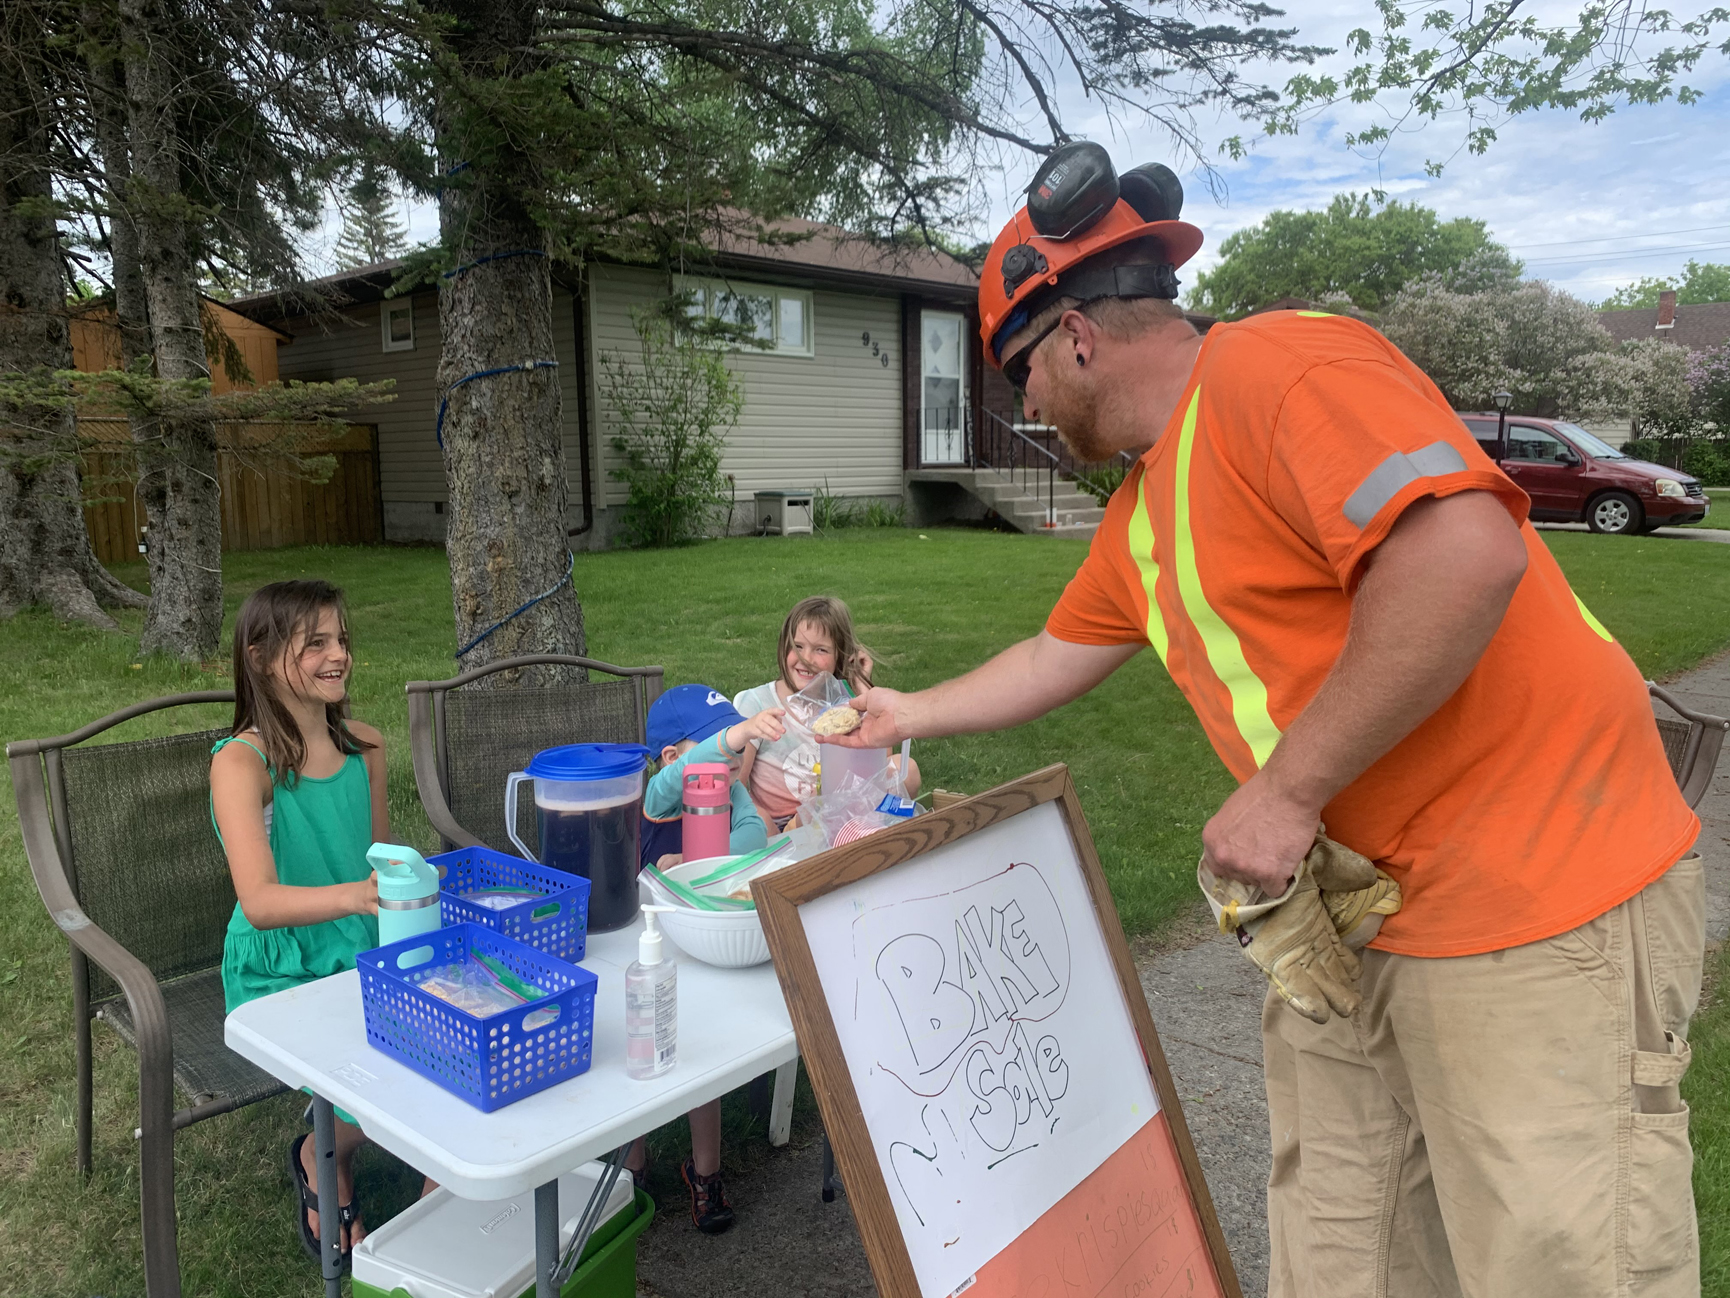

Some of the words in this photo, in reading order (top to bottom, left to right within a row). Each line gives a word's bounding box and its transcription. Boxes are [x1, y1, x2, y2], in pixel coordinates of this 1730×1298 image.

[862, 331, 889, 368] 930
[875, 899, 1060, 1075] BAKE
[966, 1022, 1069, 1152] Sale
